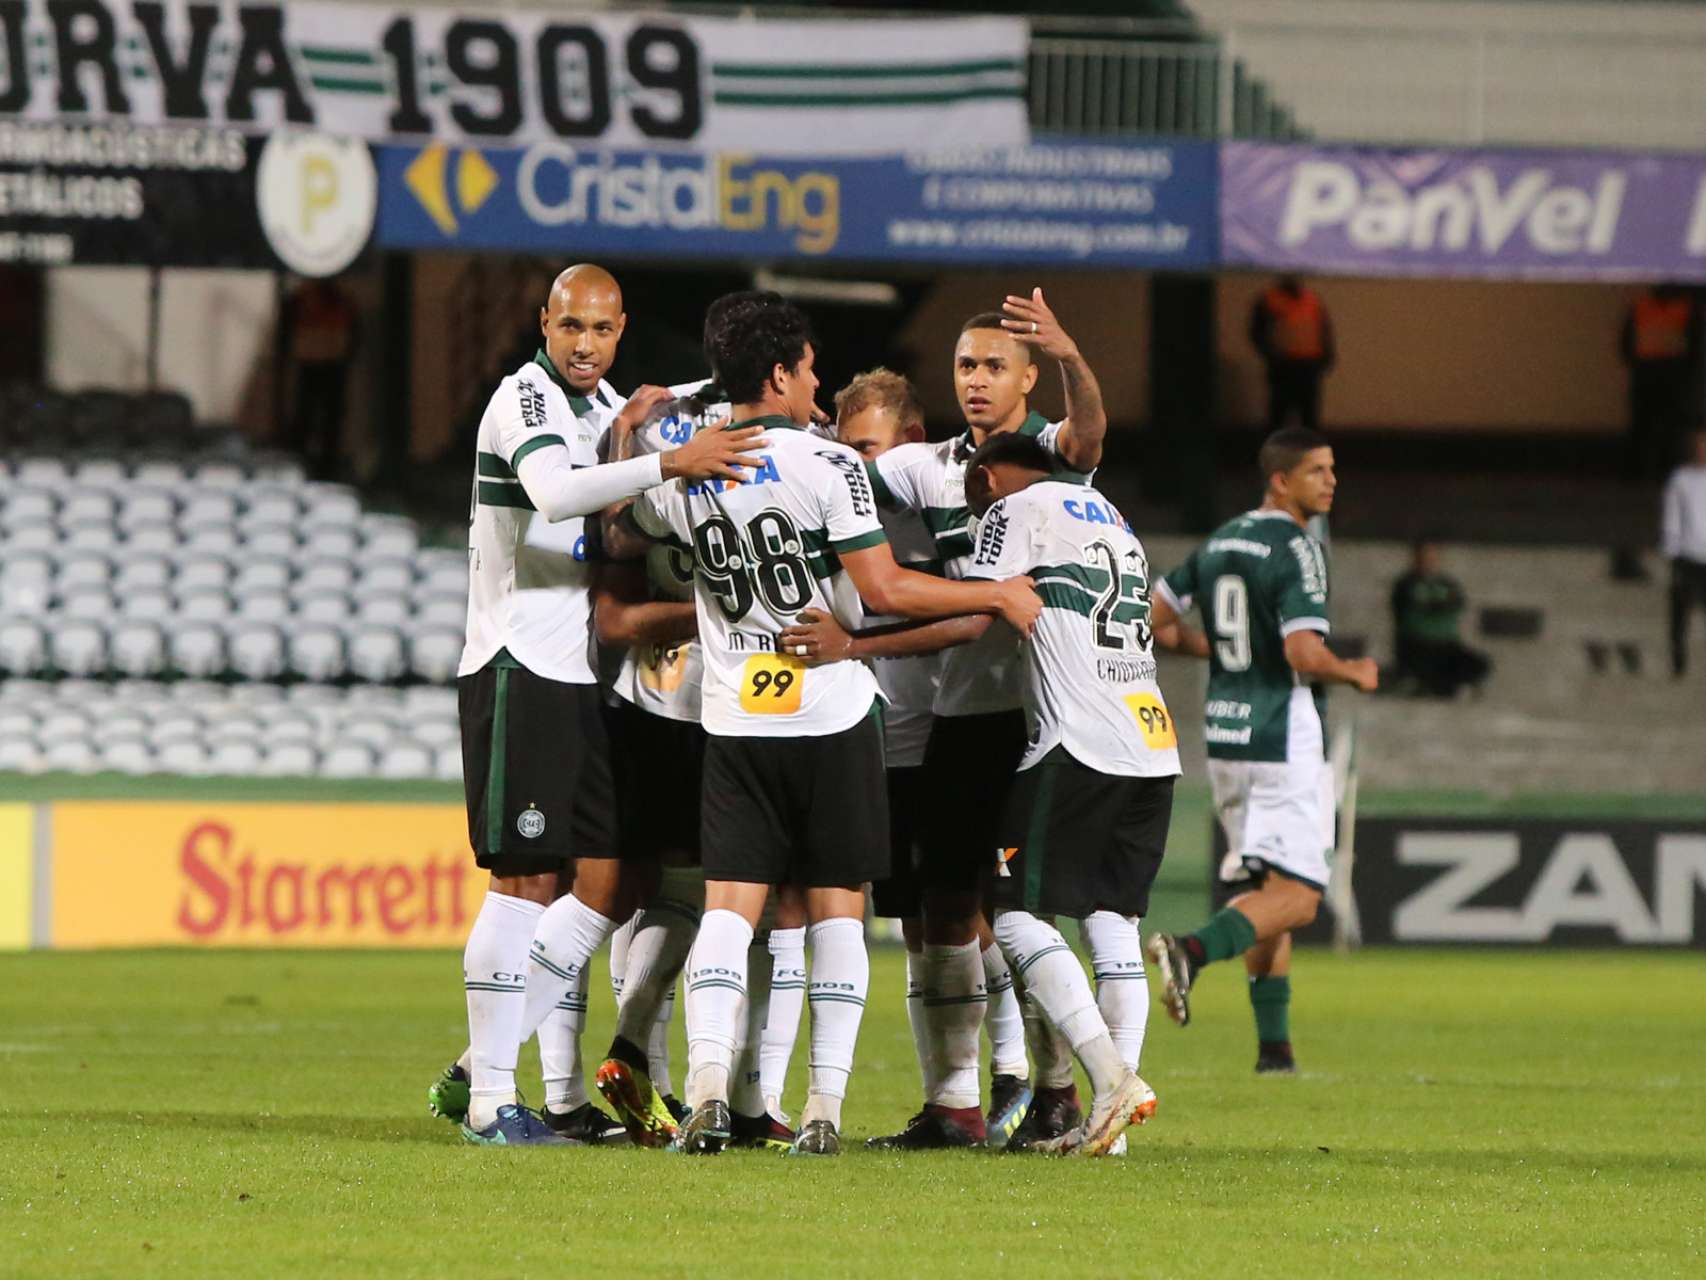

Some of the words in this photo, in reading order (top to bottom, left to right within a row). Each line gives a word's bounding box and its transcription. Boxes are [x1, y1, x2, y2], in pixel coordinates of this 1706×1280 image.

[383, 18, 703, 139] 1909
[516, 142, 840, 254] CristalEng
[1280, 161, 1628, 254] PanVel
[695, 507, 818, 624] 98
[986, 514, 1010, 566] TORK
[1213, 573, 1253, 673] 9
[752, 669, 794, 698] 99
[1138, 705, 1168, 735] 99
[178, 821, 468, 937] Starrett
